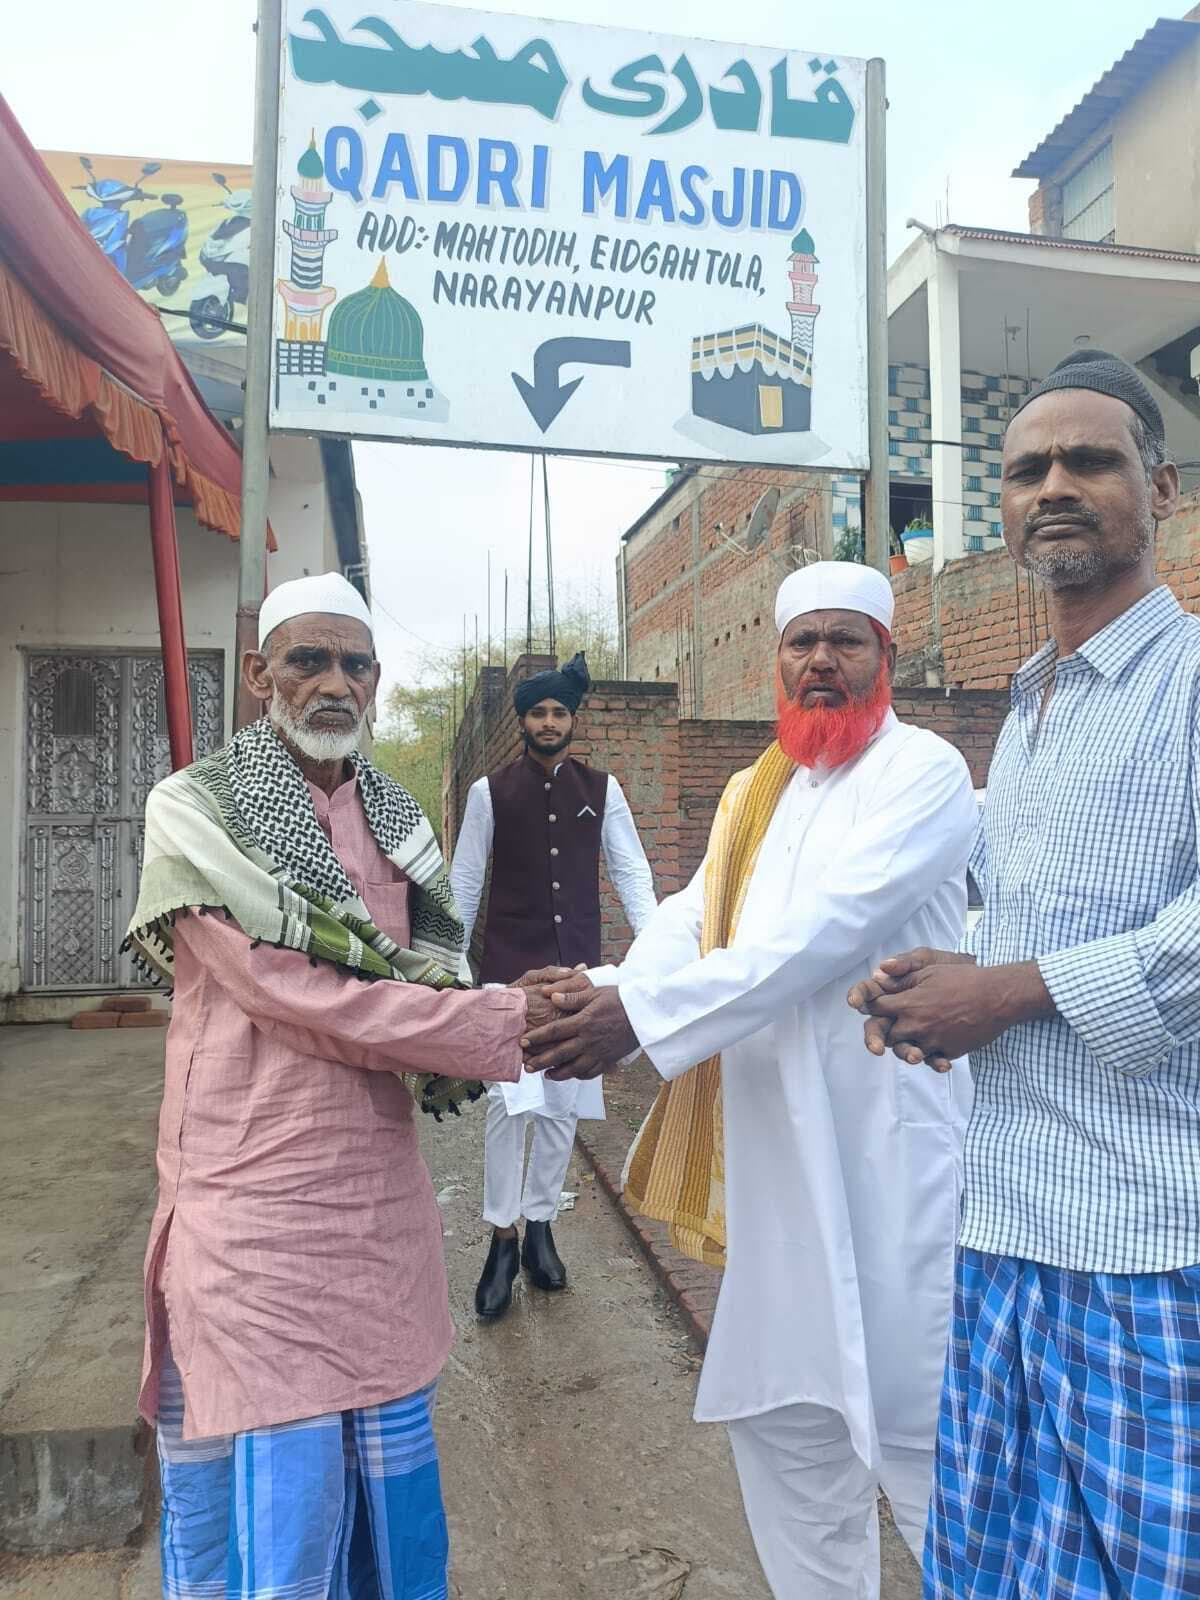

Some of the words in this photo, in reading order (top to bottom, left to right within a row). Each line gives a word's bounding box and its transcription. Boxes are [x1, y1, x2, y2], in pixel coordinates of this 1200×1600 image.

[289, 8, 569, 122] مسجد
[323, 126, 550, 210] QADRI
[582, 150, 804, 233] MASJID
[433, 270, 656, 325] NARAYANPUR
[705, 248, 766, 297] TOLA,
